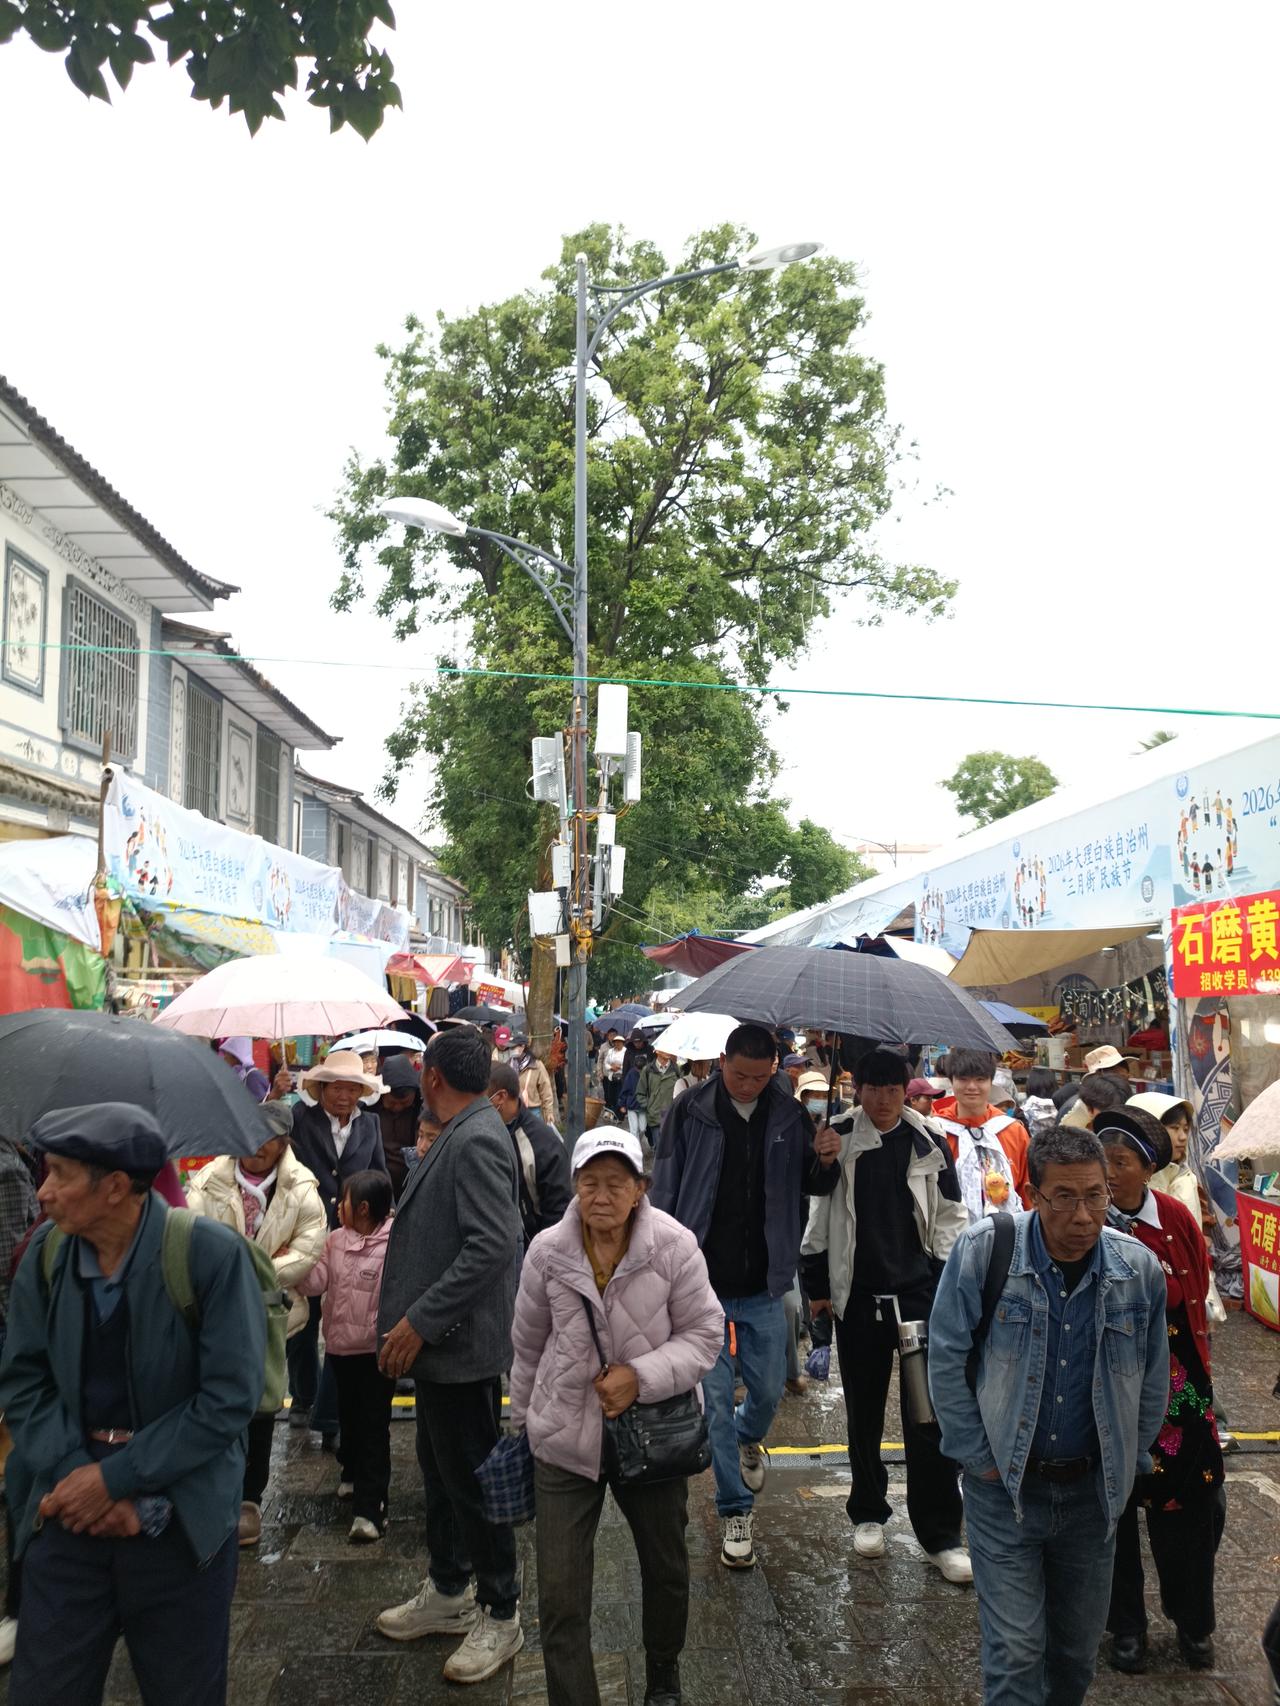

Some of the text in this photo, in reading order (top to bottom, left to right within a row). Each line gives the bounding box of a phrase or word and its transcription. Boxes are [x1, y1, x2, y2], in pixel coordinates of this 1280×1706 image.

[1047, 822, 1150, 875] 2026年大理白族自治州
[1177, 898, 1280, 967] 石磨黄
[1251, 1209, 1280, 1257] 石磨
